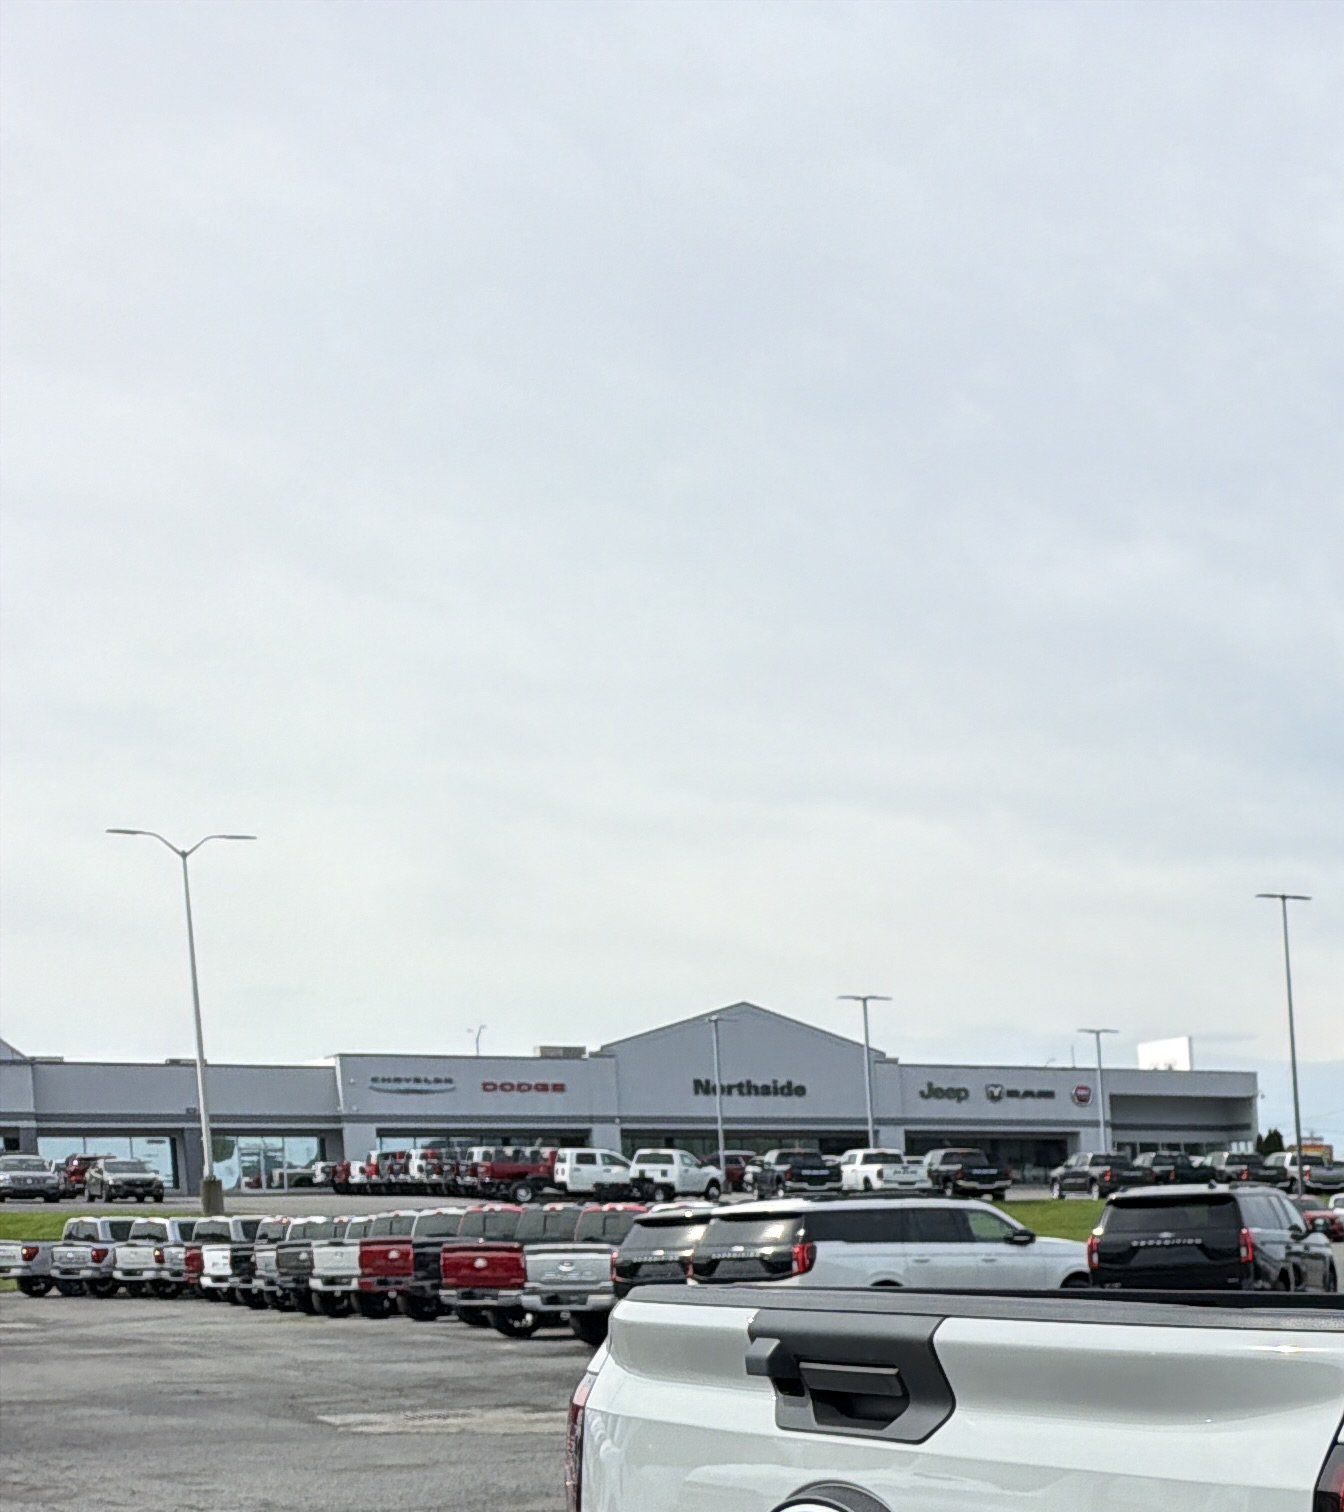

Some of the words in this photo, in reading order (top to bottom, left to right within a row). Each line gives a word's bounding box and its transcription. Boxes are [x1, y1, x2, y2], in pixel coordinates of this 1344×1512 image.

[481, 1081, 567, 1093] DODGE
[692, 1078, 807, 1097] Northside
[919, 1081, 970, 1103] Jeep
